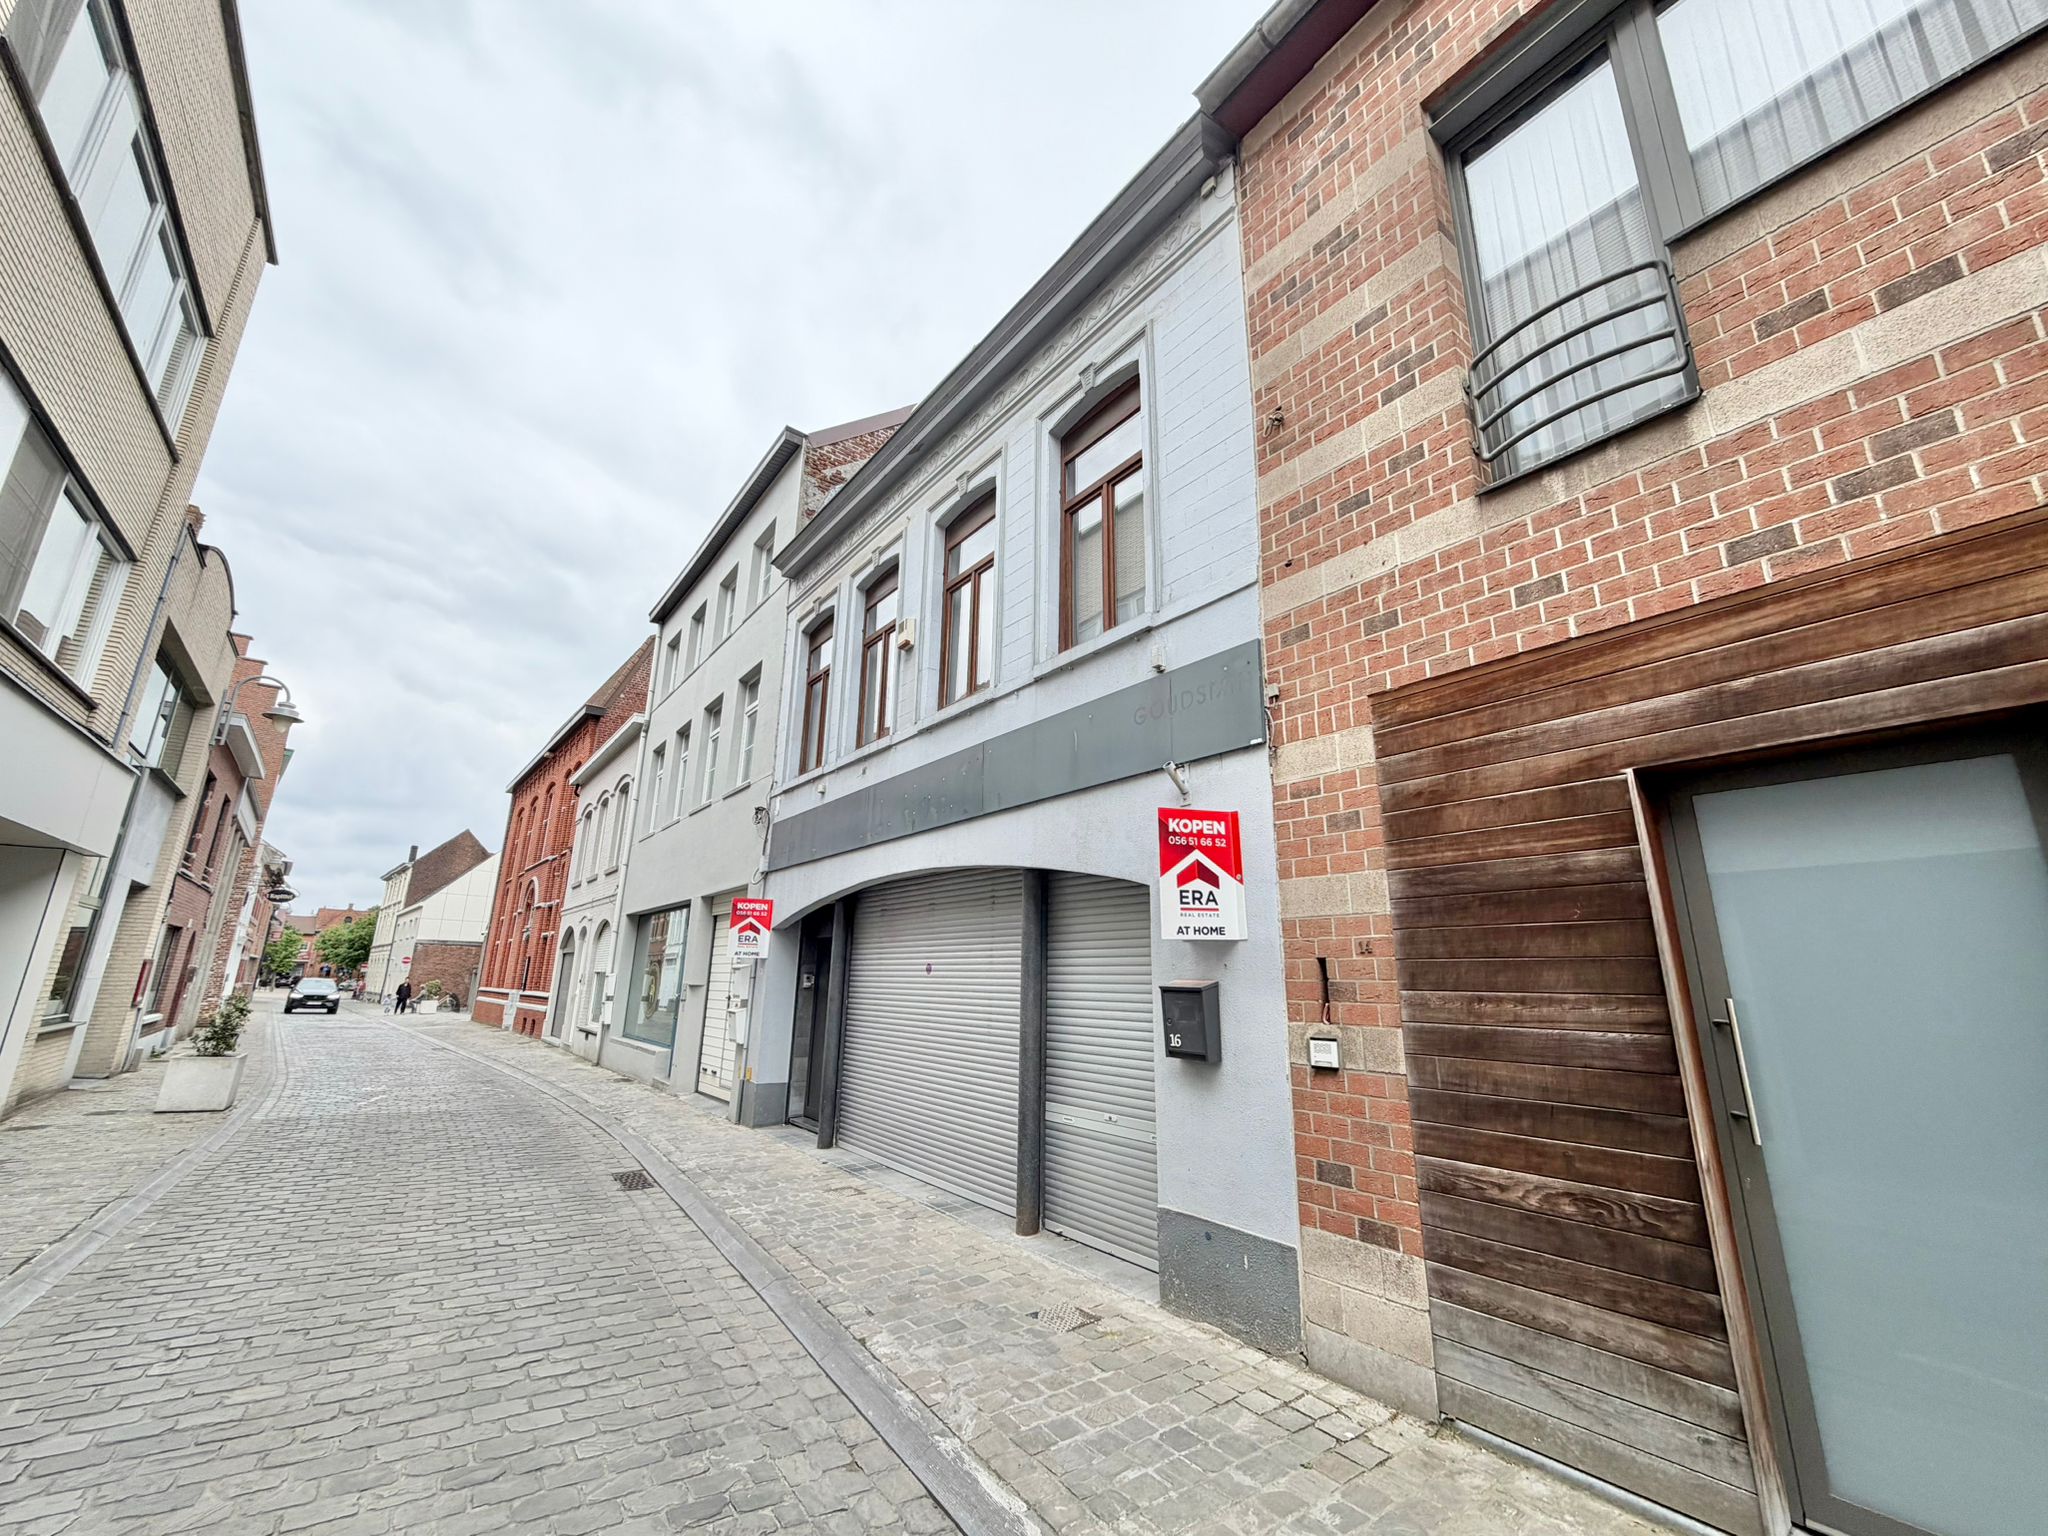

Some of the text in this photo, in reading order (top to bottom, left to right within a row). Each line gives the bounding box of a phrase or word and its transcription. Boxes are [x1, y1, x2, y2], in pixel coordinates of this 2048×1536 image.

[1168, 818, 1226, 835] KOPEN
[1168, 836, 1226, 847] 056 51 66 52
[1179, 889, 1219, 906] ERA
[737, 902, 768, 910] KOPEN
[1177, 926, 1226, 936] AT HOME
[738, 935, 758, 943] ERA
[1169, 1033, 1182, 1047] 16
